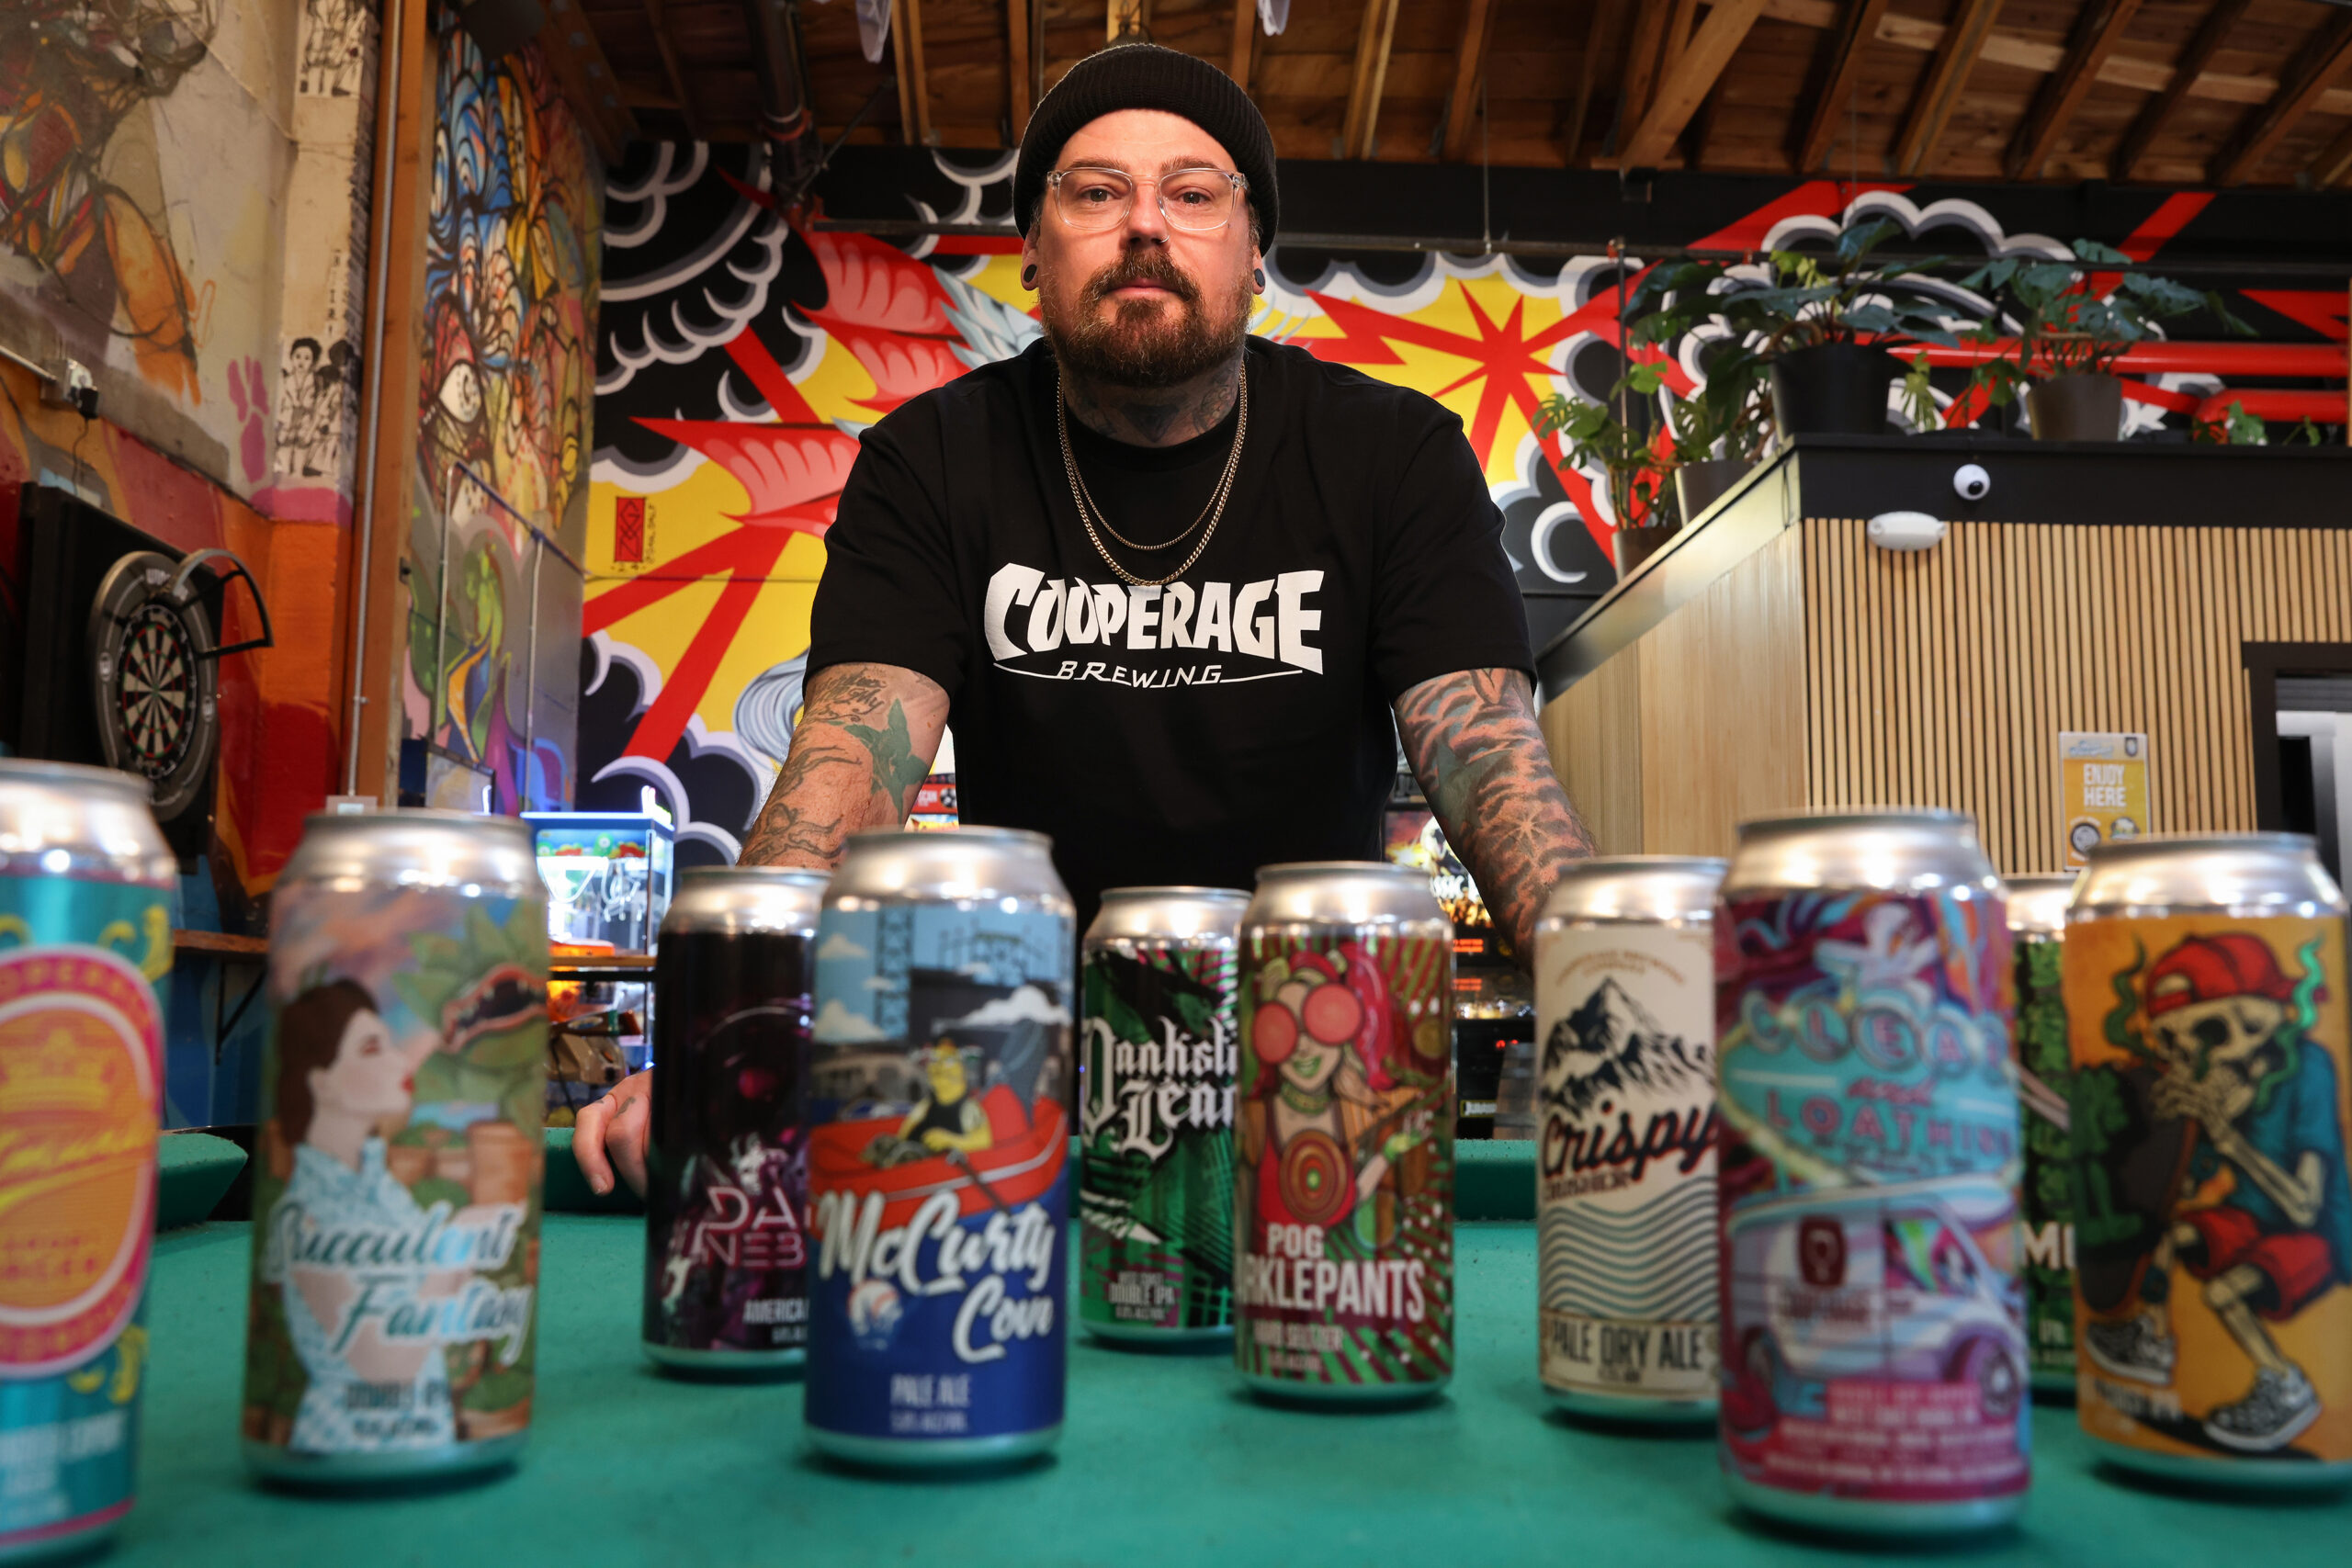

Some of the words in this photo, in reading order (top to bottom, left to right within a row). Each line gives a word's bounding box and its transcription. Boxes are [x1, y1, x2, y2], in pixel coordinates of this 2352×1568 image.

[984, 562, 1325, 675] COOPERAGE
[1055, 660, 1223, 689] BREWING
[2083, 762, 2126, 786] ENJOY
[2083, 786, 2127, 807] HERE
[1544, 1101, 1720, 1183] Crispy
[264, 1201, 516, 1279] Succulent
[1267, 1223, 1325, 1258] POG
[333, 1274, 530, 1366] Fantasy
[952, 1274, 1055, 1363] Cove
[1548, 1318, 1592, 1365] PALE
[1600, 1326, 1652, 1370] DRY
[1658, 1328, 1704, 1371] ALE
[890, 1374, 933, 1407] PALE
[937, 1375, 970, 1408] ALE
